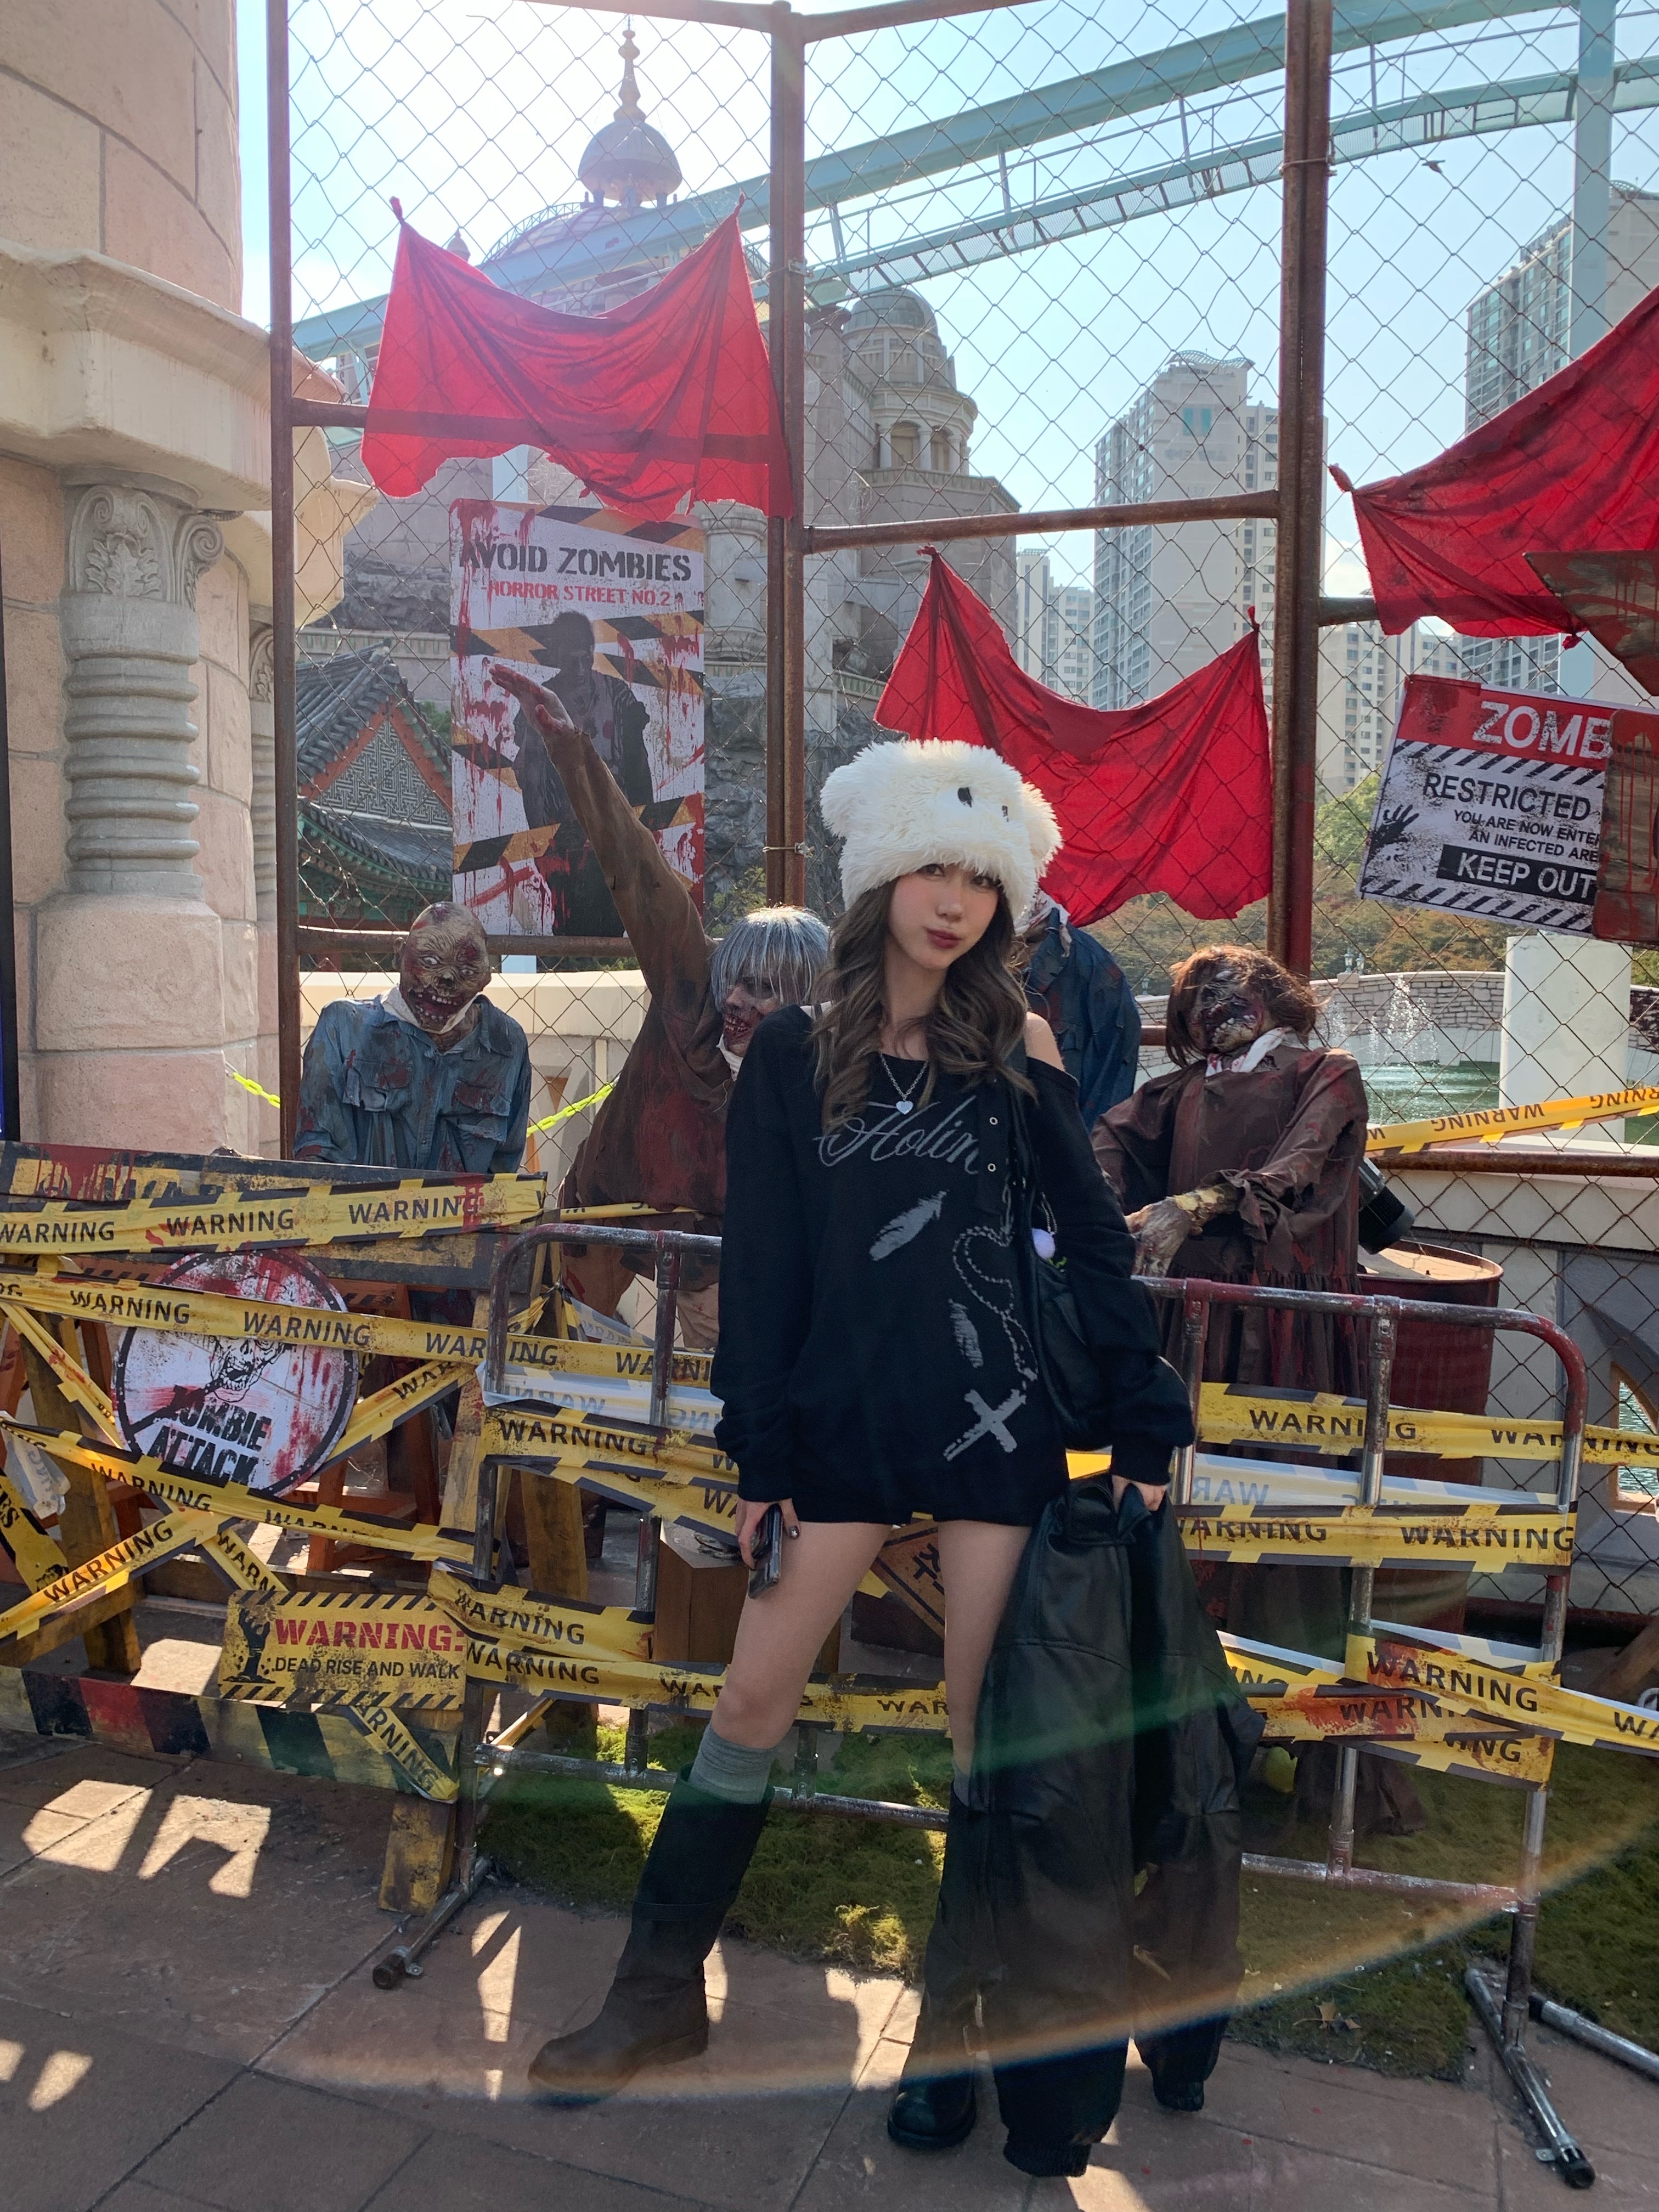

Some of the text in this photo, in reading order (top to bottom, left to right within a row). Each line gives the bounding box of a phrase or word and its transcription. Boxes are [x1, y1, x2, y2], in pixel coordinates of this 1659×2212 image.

[460, 542, 691, 582] AVOID ZOMBIES
[563, 585, 625, 604] STREET
[631, 589, 670, 607] NO.2
[1423, 772, 1592, 821] RESTRICTED
[1454, 809, 1482, 823] YOU
[1486, 816, 1516, 831] ARE
[1519, 821, 1554, 837] NOW
[1469, 831, 1490, 844] AN
[1494, 833, 1565, 856] INFECTED
[1457, 852, 1596, 899] KEEP OUT
[1431, 1103, 1545, 1132] WARNING
[0, 1195, 479, 1244] WARNING WARNING WARNING
[70, 1289, 190, 1324] WARNING
[244, 1311, 371, 1346] WARNING
[426, 1332, 558, 1366] WARING
[171, 1398, 272, 1452] OMBIE
[499, 1417, 647, 1456] WARNING
[1249, 1409, 1417, 1440] WARNIG
[147, 1425, 259, 1486] ATTACK
[1177, 1519, 1575, 1551] ARNING WARNING
[43, 1520, 173, 1604] WARNING
[275, 1618, 465, 1652] WARNING:
[455, 1588, 585, 1645] WARNING
[275, 1657, 460, 1679] DEAD RISE AND WALK
[466, 1641, 600, 1685] WARNING
[1366, 1650, 1538, 1712] WARNING
